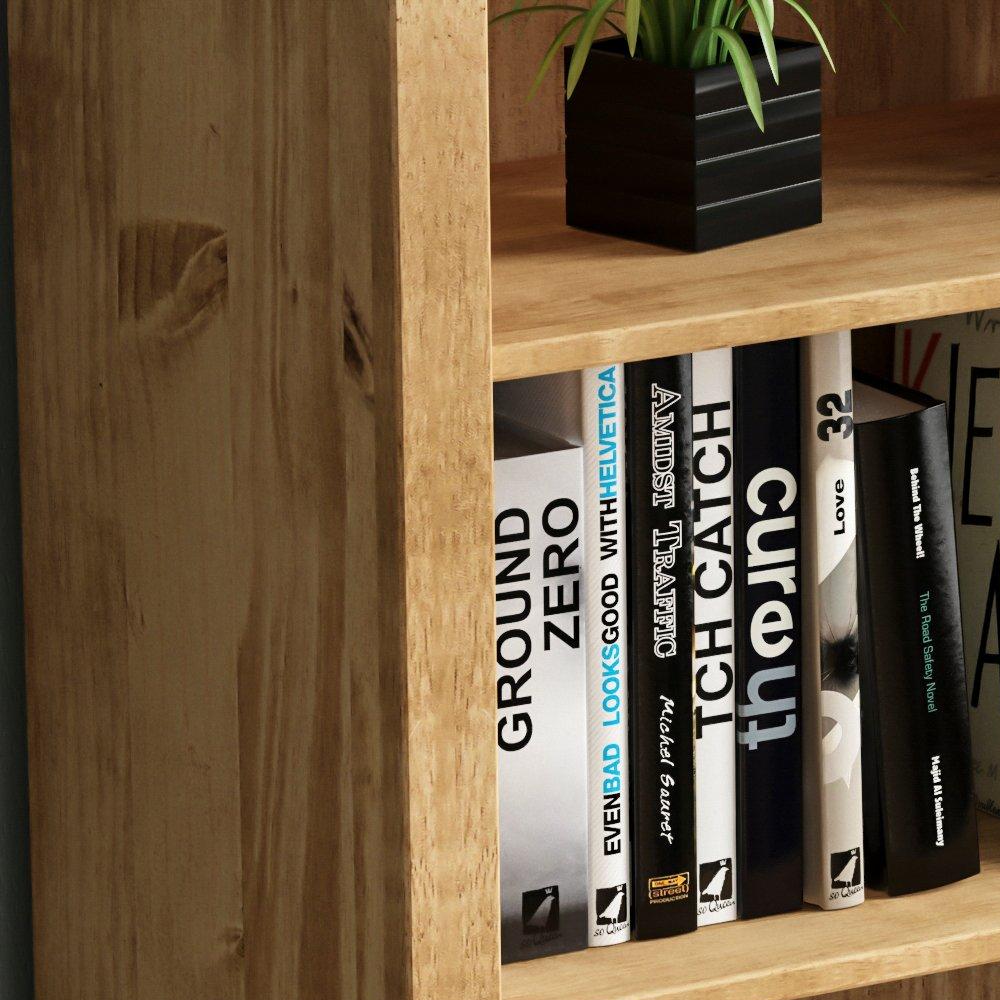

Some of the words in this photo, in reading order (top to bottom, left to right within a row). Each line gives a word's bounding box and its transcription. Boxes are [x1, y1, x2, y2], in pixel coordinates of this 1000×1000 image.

[816, 389, 854, 442] 32
[692, 400, 733, 600] CATCH
[833, 478, 845, 536] Love
[910, 467, 921, 503] Behind
[912, 503, 922, 522] The
[542, 498, 580, 651] ZERO
[652, 520, 682, 659] TRAFFIC
[919, 590, 930, 612] The
[495, 508, 533, 752] GROUND
[921, 614, 932, 644] Road
[695, 618, 733, 740] TCH
[923, 645, 935, 681] Safety
[927, 682, 938, 713] Novel
[659, 694, 675, 767] Michel
[930, 755, 942, 784] Majid
[934, 796, 945, 847] Suleimany
